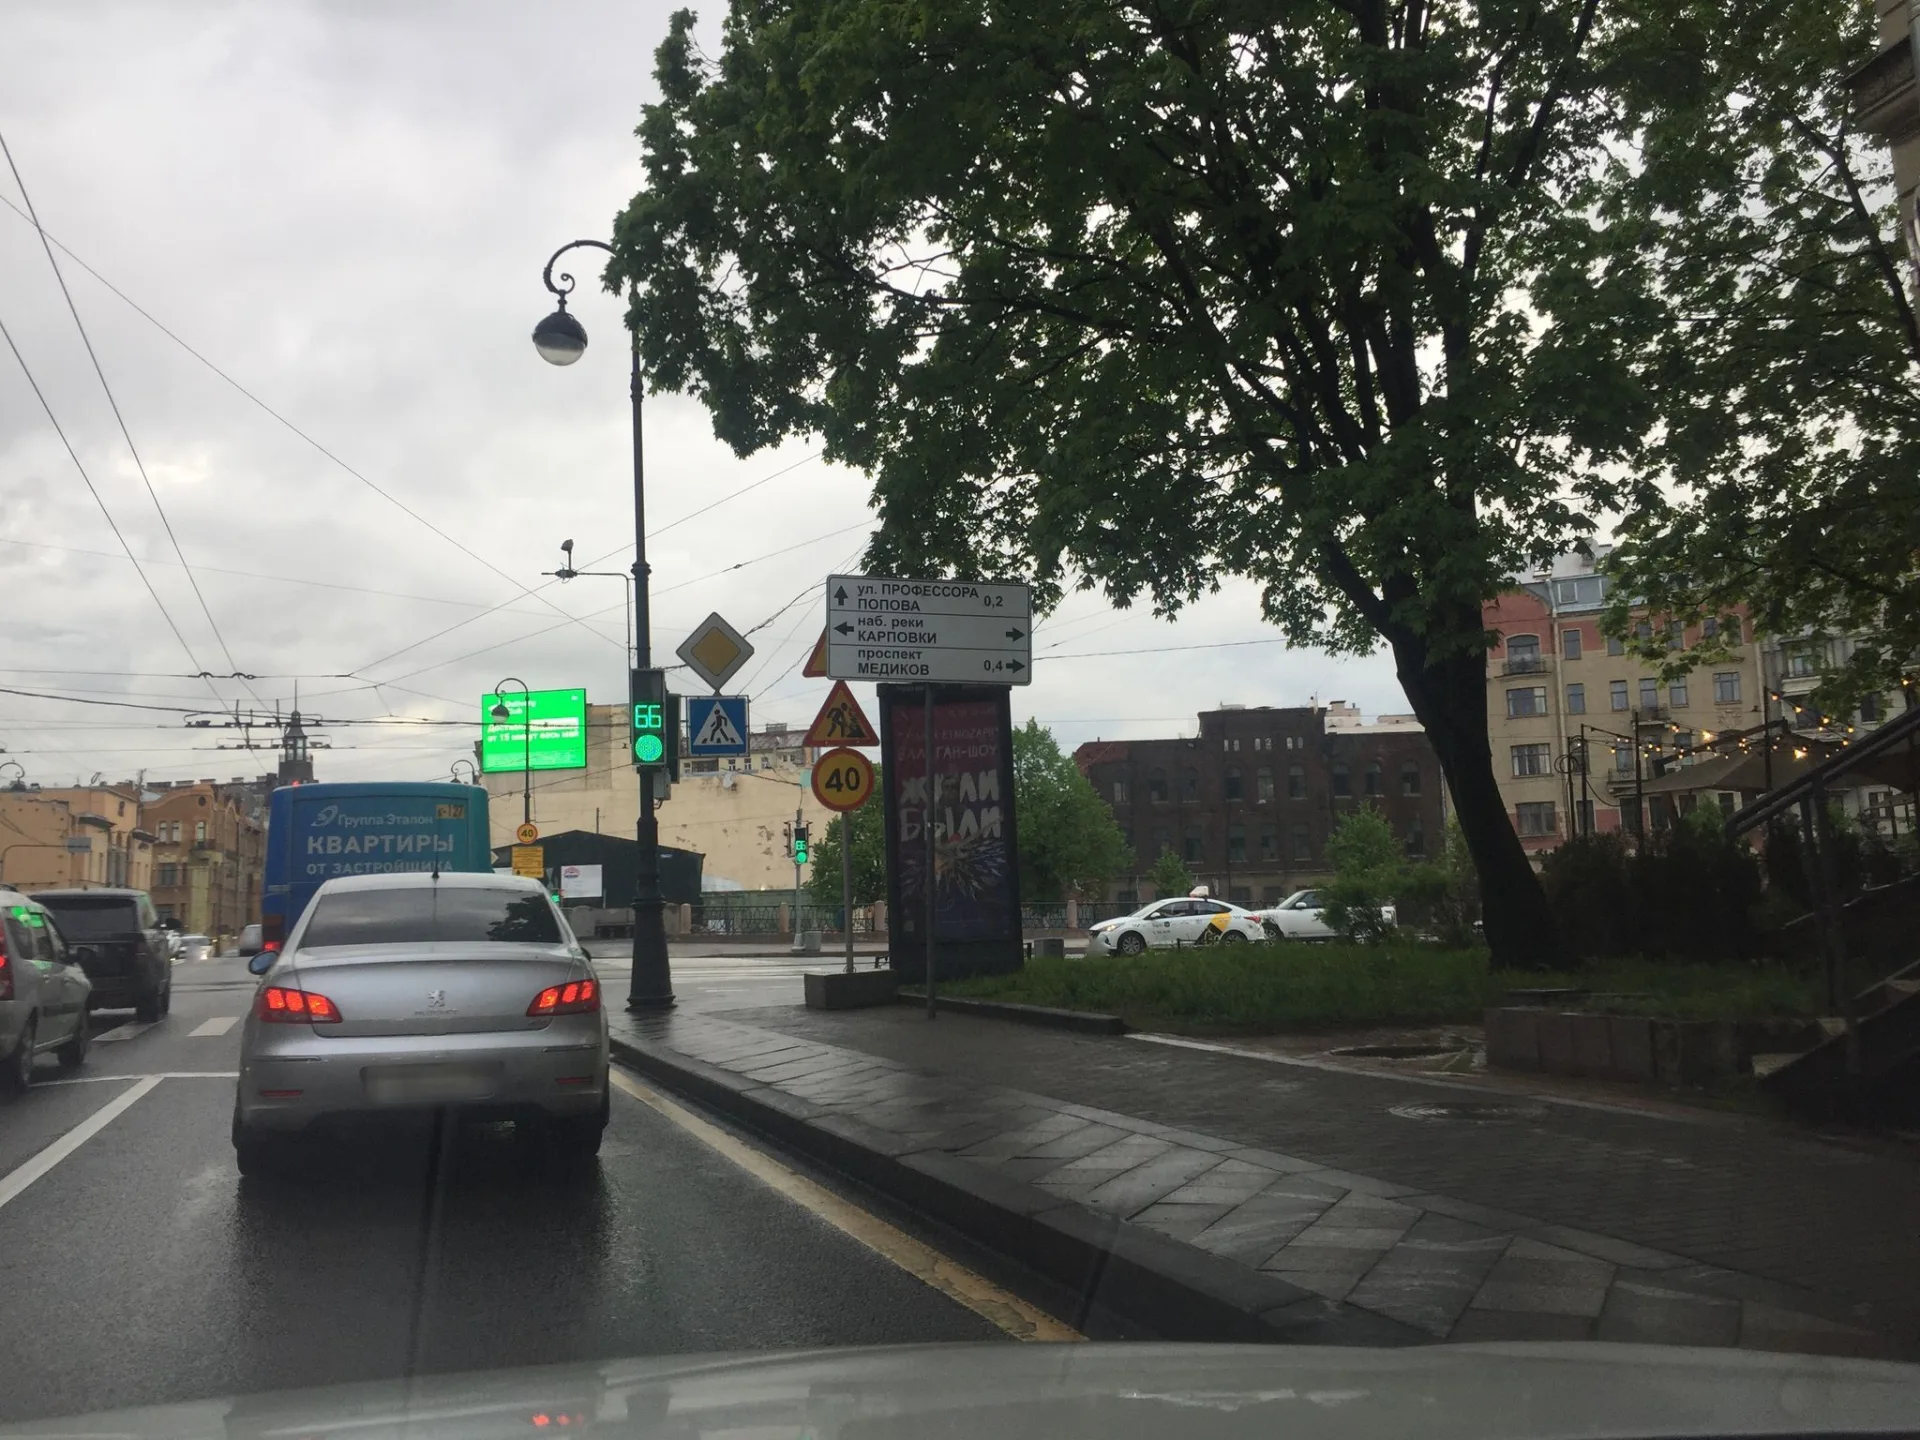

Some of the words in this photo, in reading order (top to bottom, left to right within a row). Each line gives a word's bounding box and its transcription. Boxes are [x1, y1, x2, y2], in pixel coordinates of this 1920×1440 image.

[857, 585, 877, 597] ул.
[881, 583, 979, 599] ПРОФЕССОРА
[858, 598, 921, 611] ПОПОВА
[984, 595, 1003, 608] 0,2
[858, 616, 887, 628] наб.
[892, 618, 924, 630] реки
[858, 631, 937, 644] КАРПОВКИ
[858, 650, 923, 661] проспект
[858, 662, 930, 676] МЕДИКОВ
[984, 659, 1003, 673] 0,4
[635, 704, 661, 728] 66
[898, 744, 997, 761] БАЛГАН-ШОУ
[825, 767, 860, 792] 40
[338, 814, 383, 828] Группа
[387, 814, 433, 825] Эталон
[521, 828, 533, 838] 40
[307, 834, 454, 854] КВАРТИРЫ
[332, 860, 453, 875] ЗАСТРОЙЩИКА
